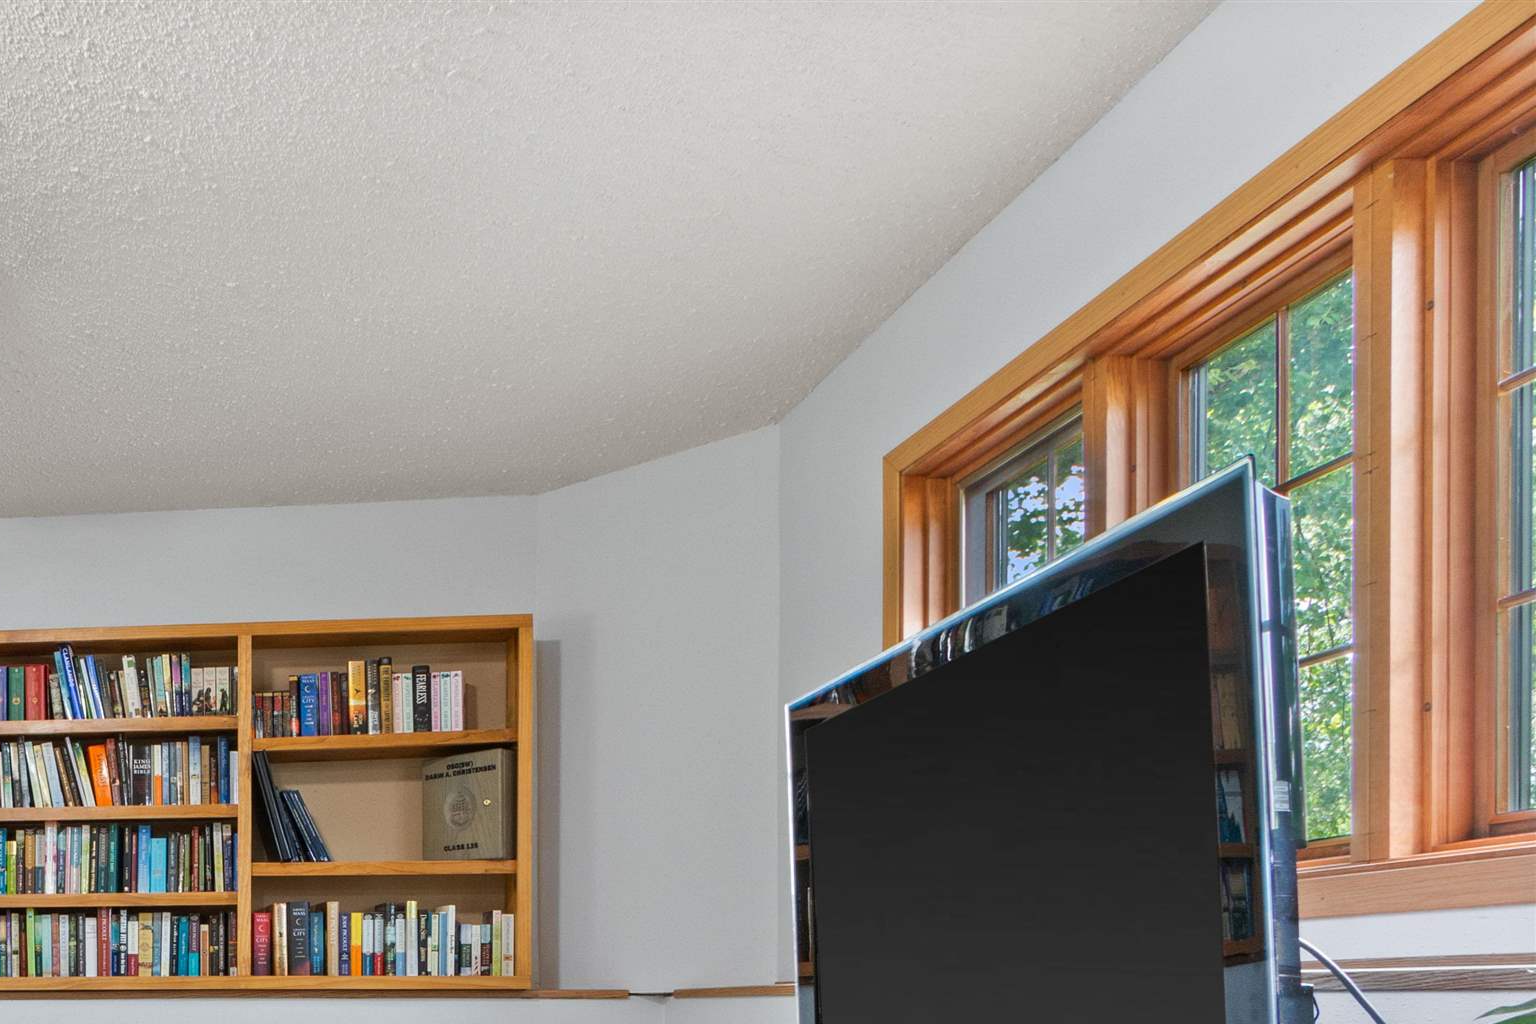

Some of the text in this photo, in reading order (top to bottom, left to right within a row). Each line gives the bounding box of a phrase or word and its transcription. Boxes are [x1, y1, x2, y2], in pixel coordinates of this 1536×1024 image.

[62, 648, 75, 688] CLANLANDS
[415, 674, 427, 704] FEARLESS
[453, 764, 497, 777] CHRISTENSEN
[444, 843, 465, 852] CLASS
